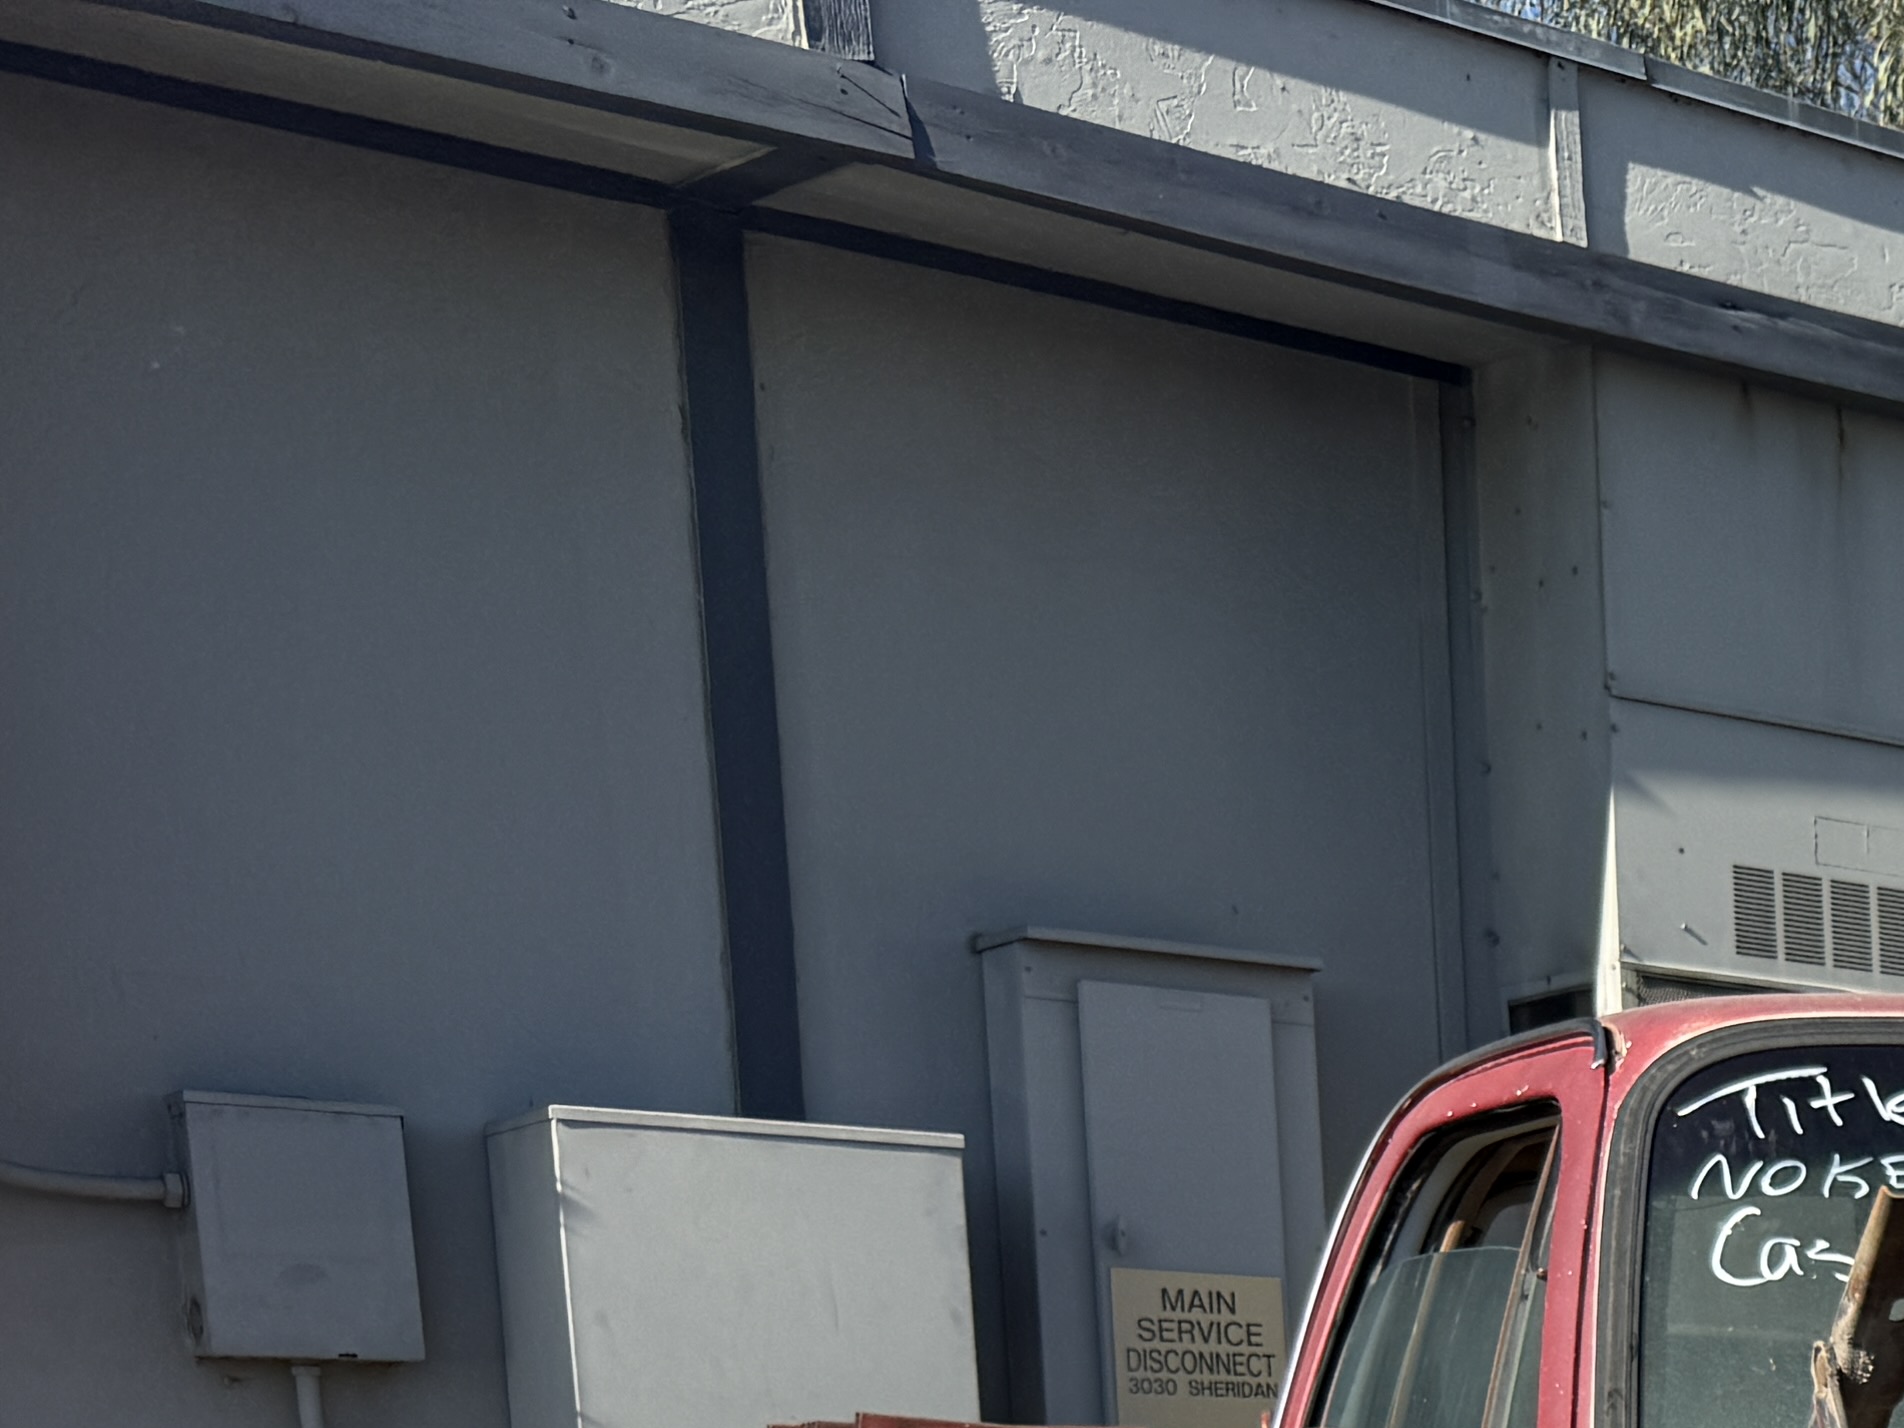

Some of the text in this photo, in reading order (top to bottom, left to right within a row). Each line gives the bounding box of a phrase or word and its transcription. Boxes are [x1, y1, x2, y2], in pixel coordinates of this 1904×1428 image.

[1691, 1154, 1808, 1200] NO
[1711, 1206, 1856, 1287] Cas
[1160, 1287, 1237, 1316] MAIN
[1136, 1317, 1264, 1348] SERVICE
[1126, 1347, 1276, 1378] DISCONNECT
[1128, 1377, 1279, 1398] 3030 SHERIDAN
